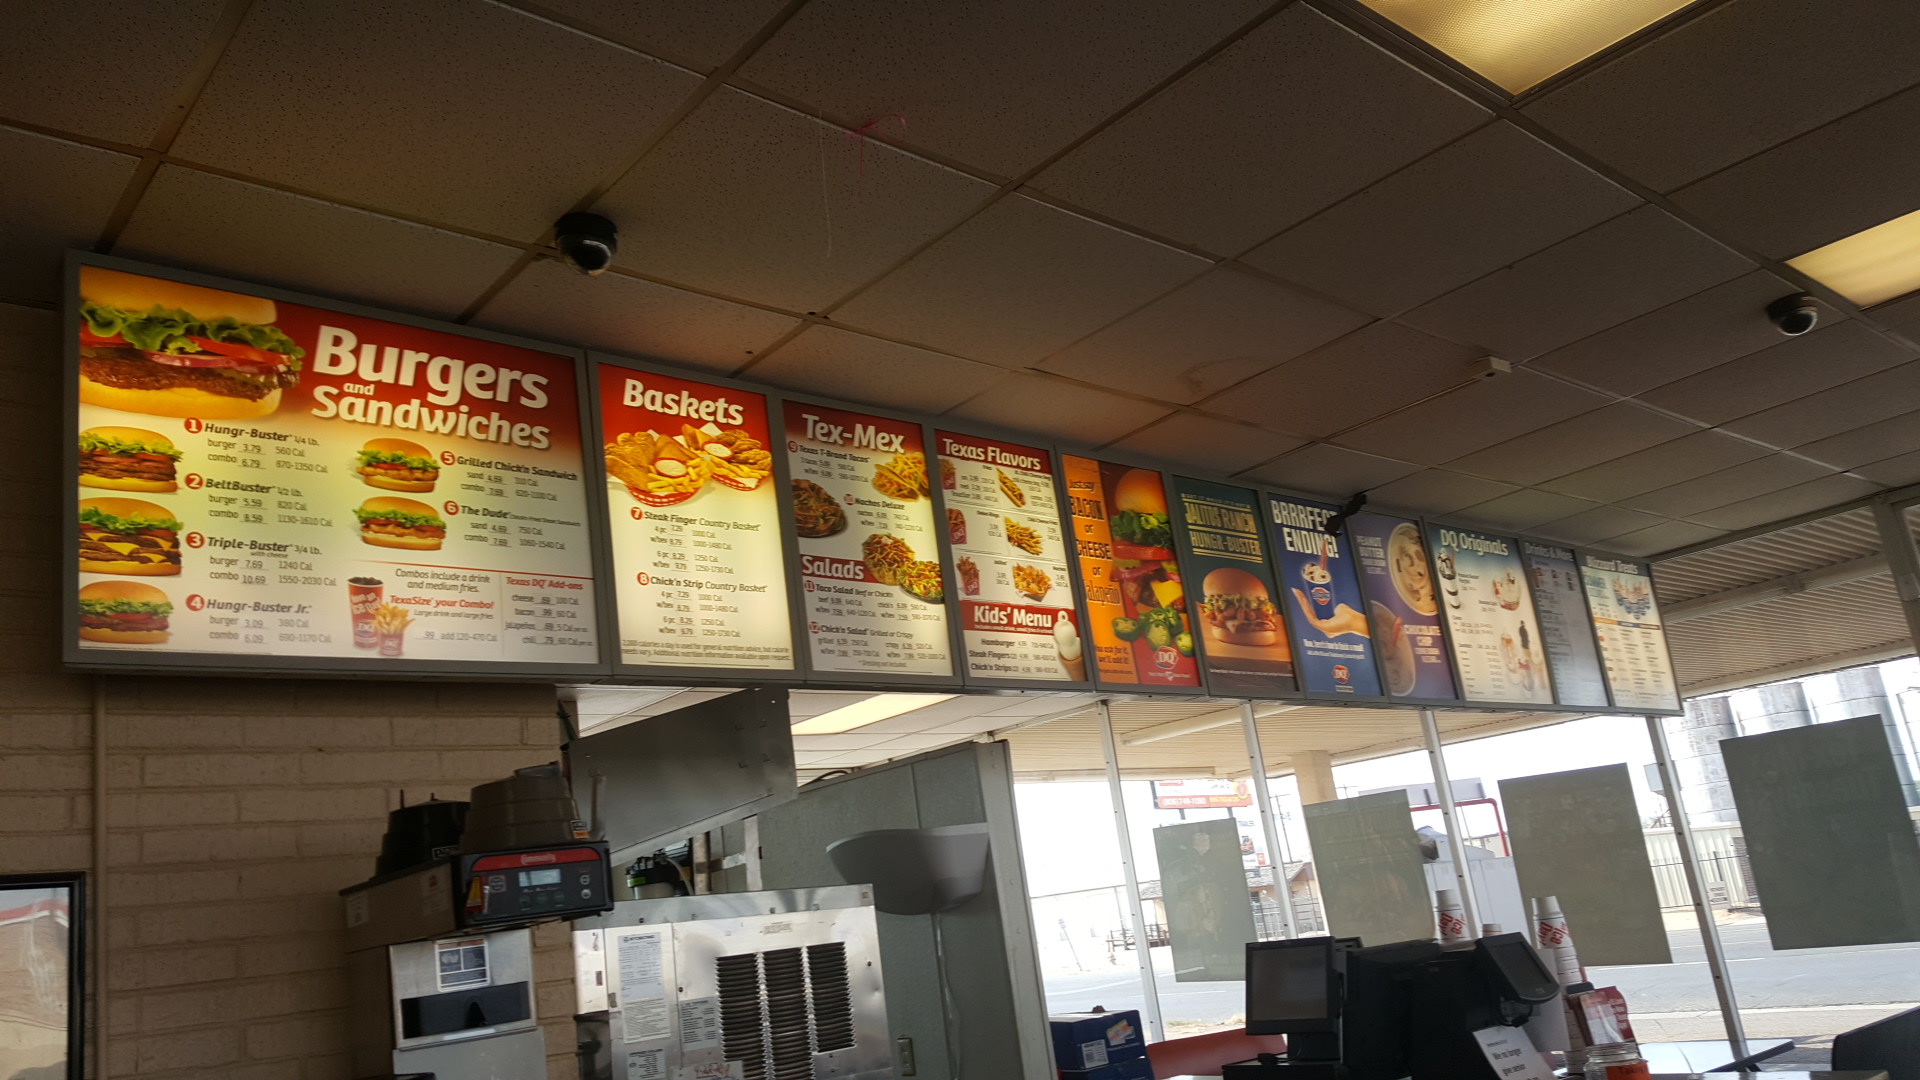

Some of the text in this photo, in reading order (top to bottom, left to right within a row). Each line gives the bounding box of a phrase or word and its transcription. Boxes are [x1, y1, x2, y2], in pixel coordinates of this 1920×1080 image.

[313, 325, 549, 408] Burgers
[343, 383, 375, 395] and
[623, 378, 744, 425] Baskets
[311, 385, 550, 449] Sandwiches
[205, 423, 289, 442] Hungr-Buster
[802, 414, 905, 453] Tex-Mex
[207, 439, 236, 450] burger
[243, 444, 261, 453] 3.79
[207, 454, 260, 467] combo 6.79
[800, 445, 818, 455] Texas
[849, 454, 868, 463] Tacos
[943, 438, 1041, 470] Texas Flavors
[457, 456, 492, 468] Grilled
[532, 467, 578, 480] Sandwich
[205, 478, 272, 493] BeltBuster
[209, 495, 238, 505] burger
[855, 498, 905, 510] Nachos Deluxe
[209, 510, 238, 518] combo
[461, 506, 479, 515] The
[482, 508, 507, 518] Dude
[1069, 496, 1105, 520] BACON
[644, 512, 669, 521] Steak
[671, 515, 697, 525] Finger
[700, 518, 731, 529] Country
[732, 522, 759, 531] Basket
[1221, 509, 1257, 533] RANCH
[207, 537, 289, 552] Triple-Buster
[464, 534, 488, 542] combo
[1189, 531, 1262, 555] HUNGR-BUSTER
[1282, 527, 1339, 558] ENDING!
[1440, 529, 1508, 555] DQ Originals
[1076, 539, 1112, 560] CHEESE
[210, 556, 298, 569] burger 7.69 1240
[802, 556, 864, 580] Salads
[1616, 560, 1638, 574] Treats
[210, 571, 239, 580] combo
[243, 575, 266, 583] 10.69
[396, 568, 429, 579] Combos
[431, 571, 460, 580] include
[468, 574, 490, 582] drink
[426, 582, 458, 591] medium
[650, 577, 681, 586] Chick'n
[683, 580, 703, 589] Strip
[705, 582, 737, 592] Country
[739, 584, 765, 592] Basket
[816, 584, 831, 592] Taco
[833, 586, 853, 594] Salad
[207, 599, 293, 613] Hungr-Buster
[434, 599, 457, 608] your
[460, 599, 494, 608] Combo!
[209, 616, 238, 626] burger
[974, 606, 1052, 627] Kids' Menu
[209, 631, 239, 639] combo
[821, 625, 845, 634] Chick'n
[981, 638, 1015, 648] Hamburger
[969, 650, 1010, 660] Steak Fingers
[1159, 652, 1175, 664] DQ
[971, 663, 1012, 672] Chick'n Strips
